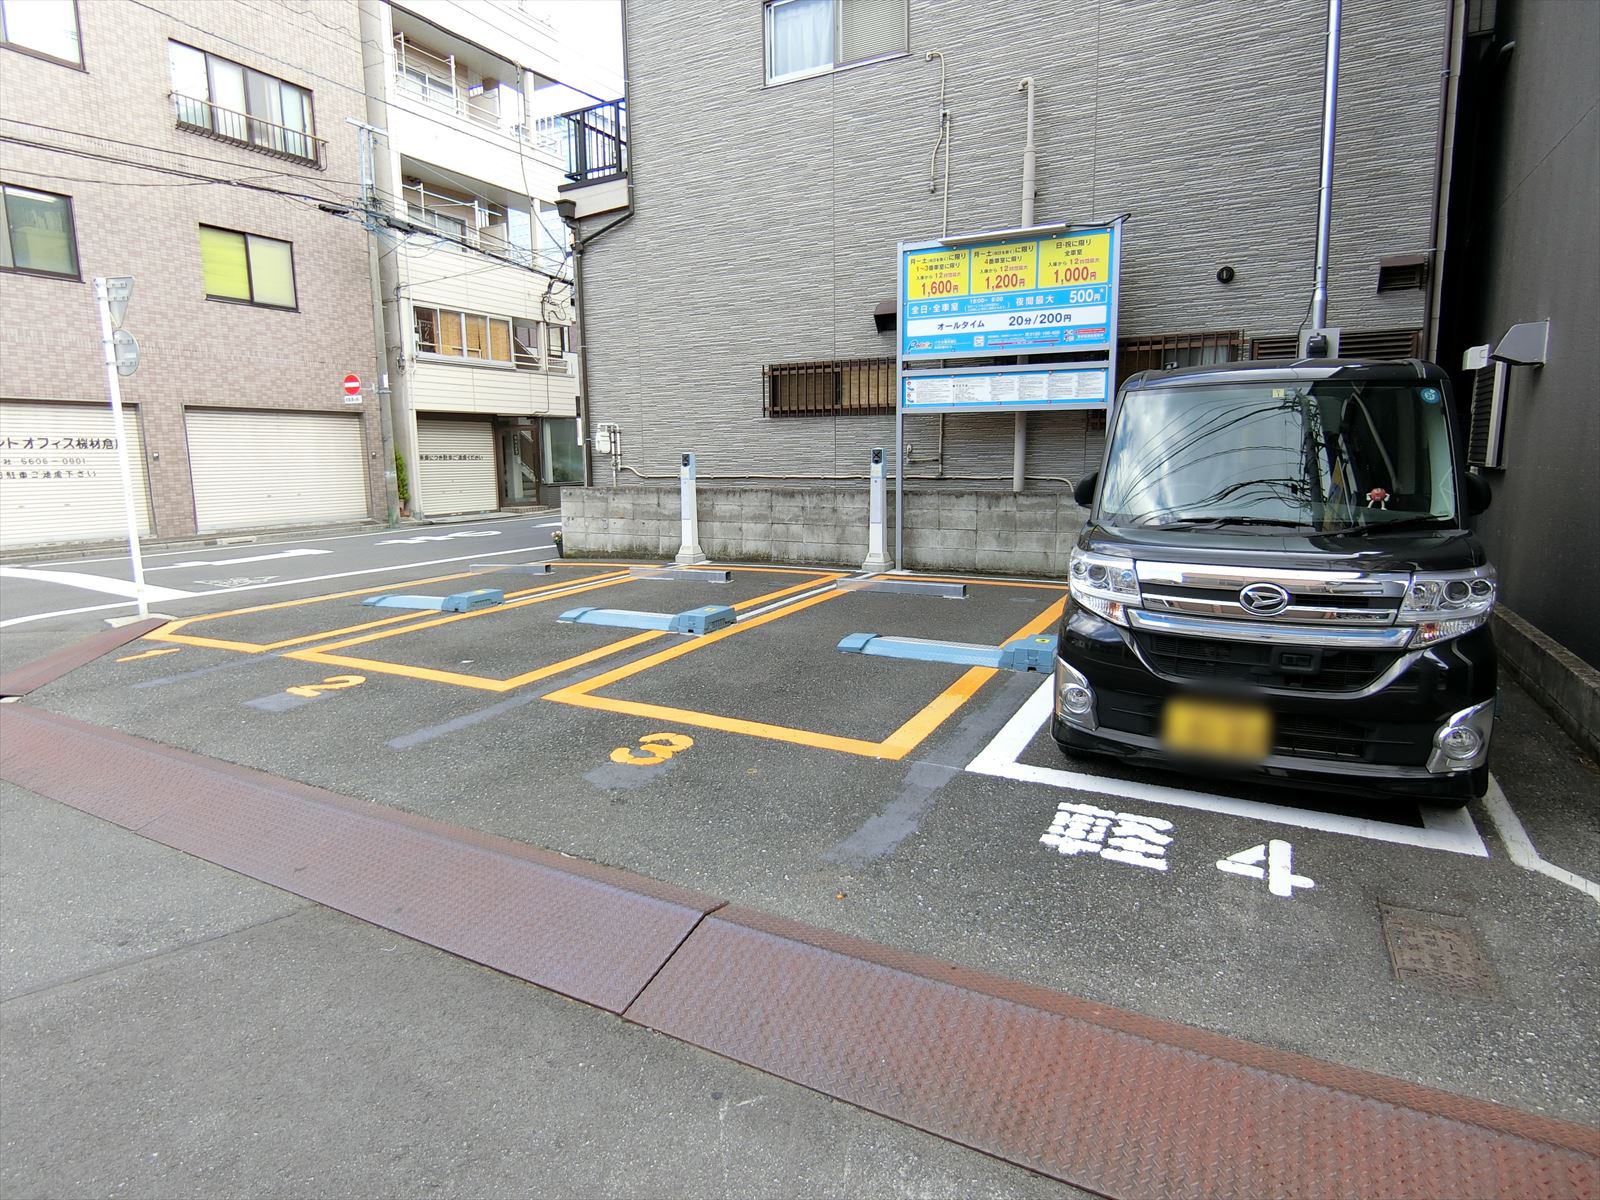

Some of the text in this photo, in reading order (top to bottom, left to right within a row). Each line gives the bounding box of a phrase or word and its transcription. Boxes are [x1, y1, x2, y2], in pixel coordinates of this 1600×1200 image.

[985, 273, 1025, 291] 1,200円
[1054, 266, 1097, 285] 1,000円
[921, 280, 959, 297] 1,600円
[1015, 295, 1055, 306] 夜間最大
[937, 320, 985, 331] オールタイム
[286, 675, 367, 697] 2
[609, 732, 694, 766] 3
[1216, 839, 1316, 897] 4
